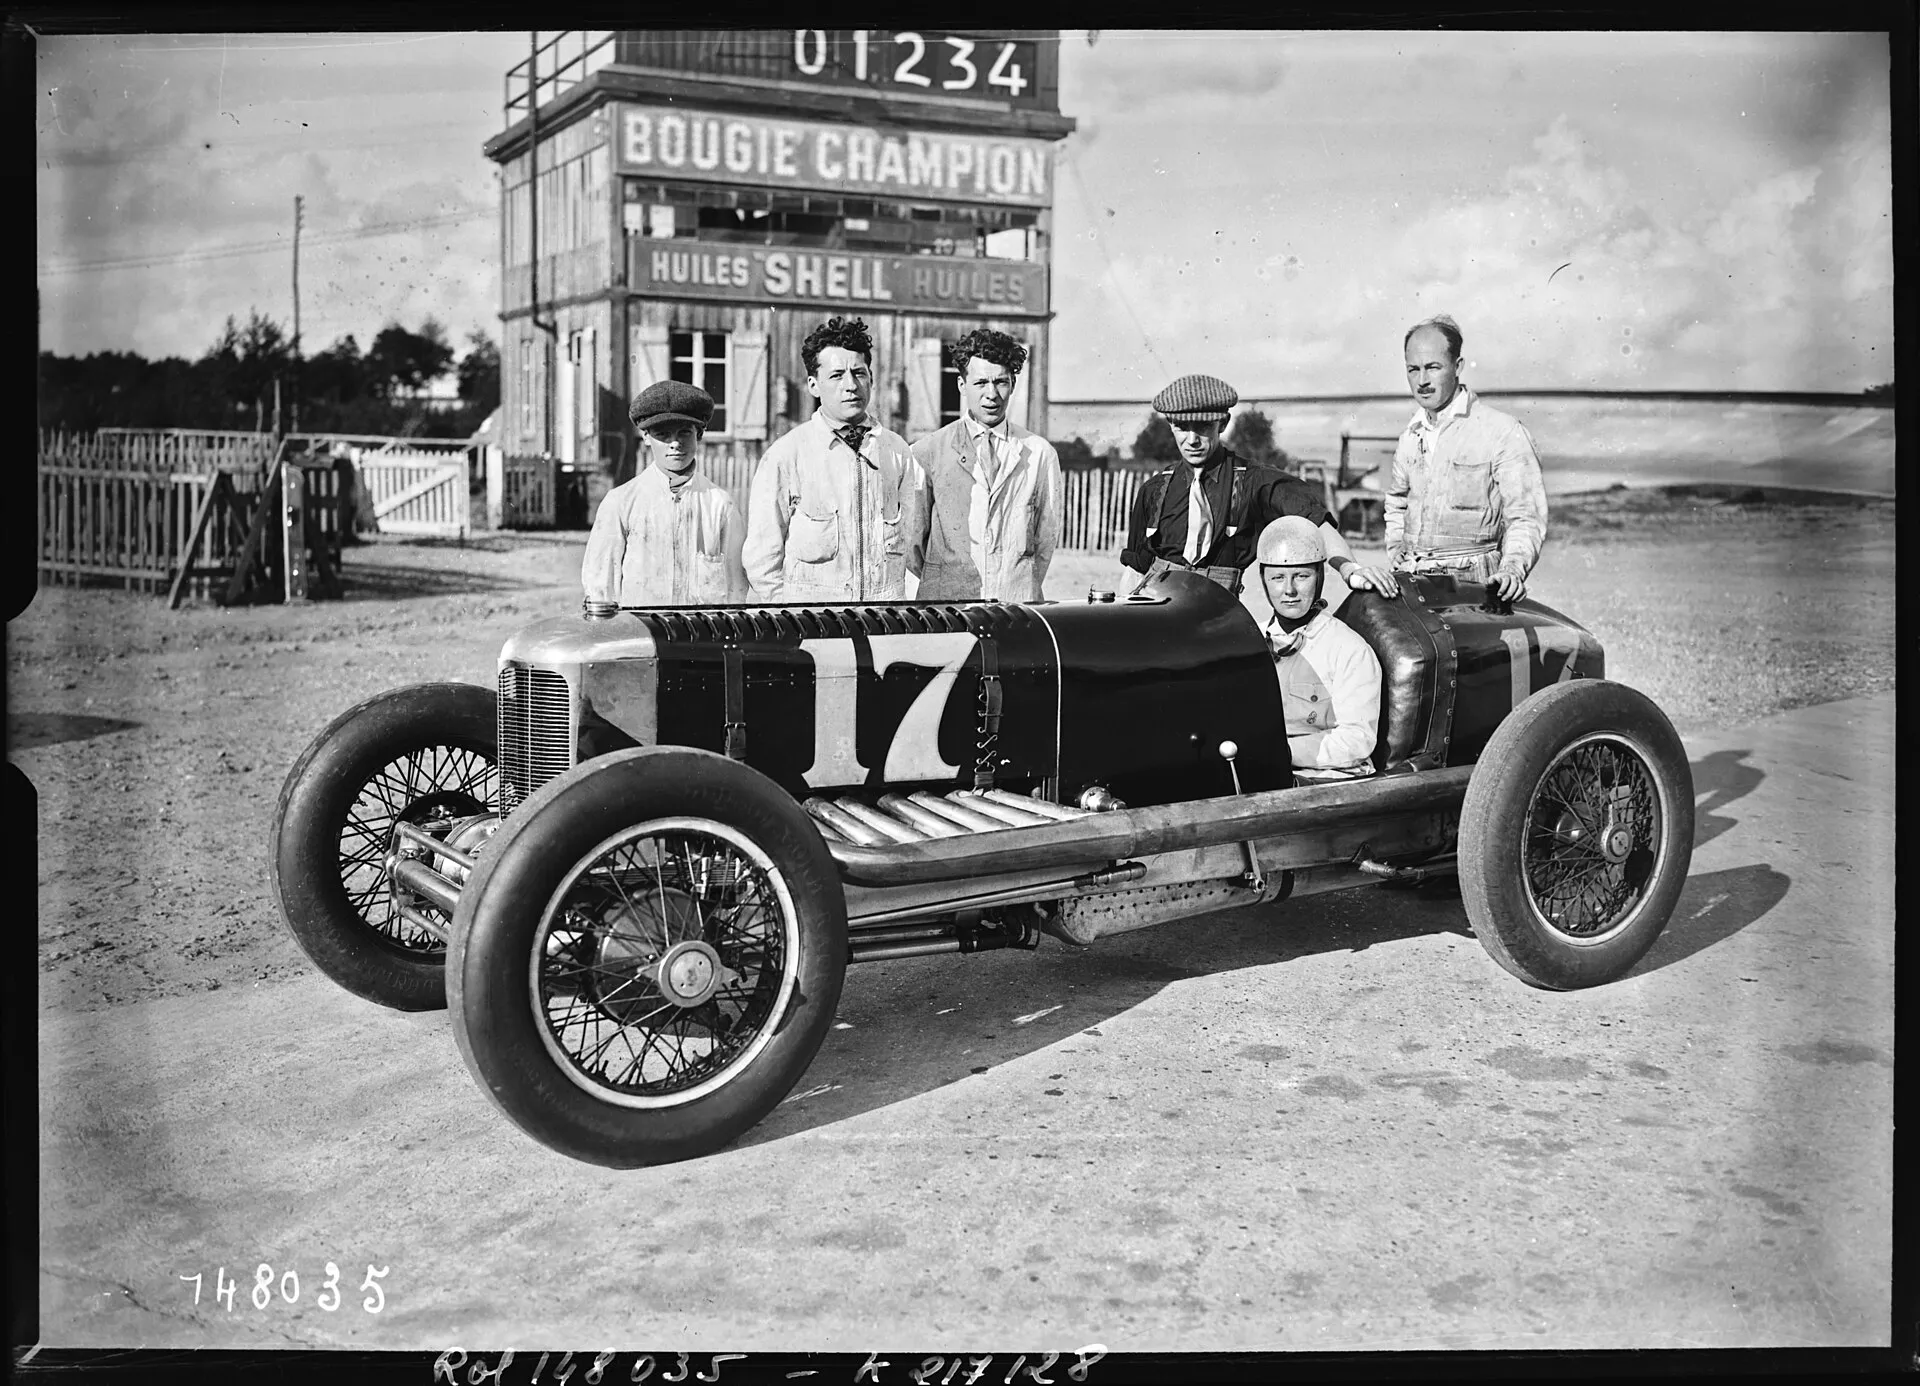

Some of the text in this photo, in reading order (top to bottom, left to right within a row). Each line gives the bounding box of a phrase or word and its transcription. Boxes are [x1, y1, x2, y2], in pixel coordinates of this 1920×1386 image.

[623, 112, 1047, 194] BOUGIE CHAMPION
[652, 250, 750, 289] HUILES
[911, 267, 1025, 302] HUILES
[800, 631, 979, 789] 17
[1500, 625, 1581, 712] 17
